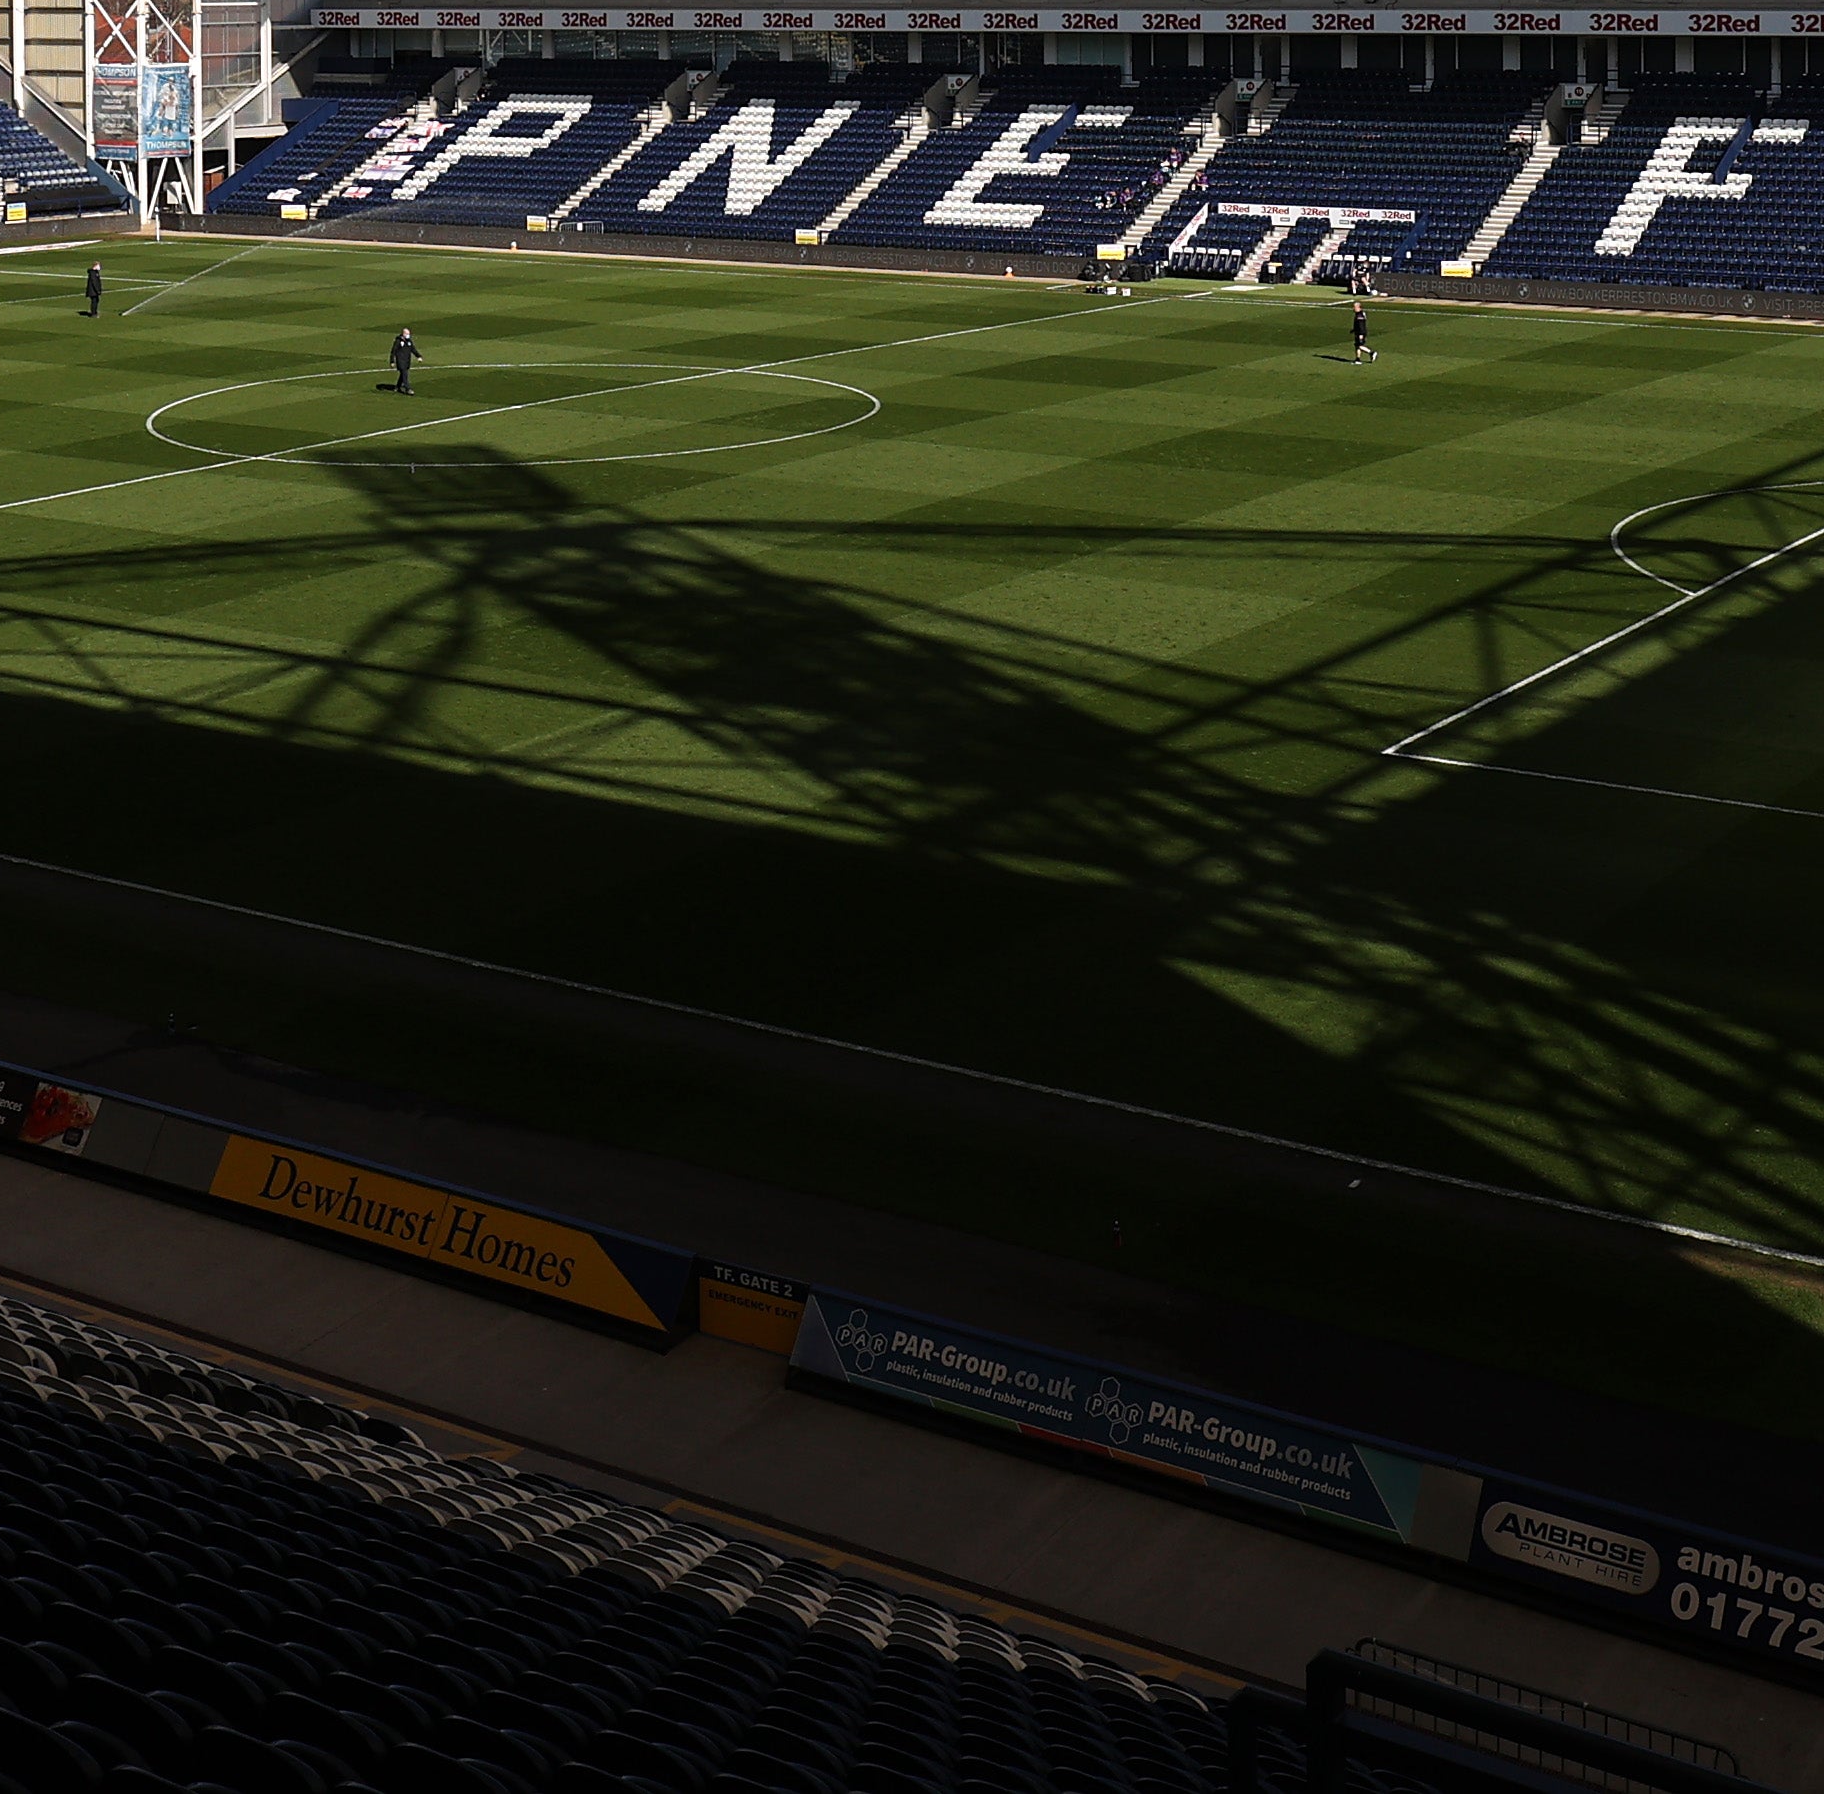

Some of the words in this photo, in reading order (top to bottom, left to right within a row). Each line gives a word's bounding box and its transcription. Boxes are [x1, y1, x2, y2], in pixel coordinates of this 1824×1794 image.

[377, 11, 419, 27] 32Red
[498, 11, 543, 27] 32Red
[626, 12, 674, 28] 32Red
[763, 12, 813, 29] 32Red
[908, 12, 961, 29] 32Red
[1062, 13, 1118, 30] 32Red
[1226, 13, 1286, 31] 32Red
[1401, 13, 1466, 31] 32Red
[1589, 14, 1658, 32] 32Red
[390, 93, 593, 200] P
[636, 98, 861, 216] N
[1592, 117, 1810, 257] F
[1221, 204, 1250, 213] 32Red
[1261, 206, 1290, 215] 32Red
[1300, 208, 1329, 217] 32Red
[1340, 210, 1370, 219] 32Red
[1381, 211, 1411, 220] 32Red
[1383, 277, 1428, 292] BOWKER
[1431, 278, 1482, 294] PRESTON
[1484, 280, 1511, 296] BMW
[1535, 287, 1734, 310] WWW.BOWKERPRESTONBMW.CO.UK
[1763, 297, 1795, 311] VISIT:
[258, 1154, 435, 1246] Dewhurst
[440, 1204, 576, 1288] Homes
[713, 1266, 735, 1283] TF.
[739, 1271, 779, 1295] GATE
[782, 1283, 794, 1297] 2
[708, 1288, 772, 1313] EMERGENCY
[774, 1306, 798, 1320] EXIT
[838, 1328, 886, 1352] PAR
[890, 1329, 1077, 1402] PAR-Group.co.uk
[885, 1359, 920, 1380] plastic,
[922, 1369, 971, 1393] insulation
[972, 1383, 992, 1399] and
[992, 1387, 1027, 1409] rubber
[1028, 1400, 1074, 1423] products
[1090, 1398, 1140, 1422] PAR
[1147, 1399, 1354, 1480] PAR-Group.co.uk
[1142, 1431, 1182, 1455] plastic,
[1184, 1443, 1238, 1470] insulation
[1239, 1459, 1261, 1476] and
[1262, 1464, 1300, 1487] rubber
[1301, 1476, 1352, 1502] products
[1494, 1512, 1647, 1568] AMBROSE
[1519, 1544, 1583, 1569] PLANT
[1596, 1564, 1642, 1587] HIRE
